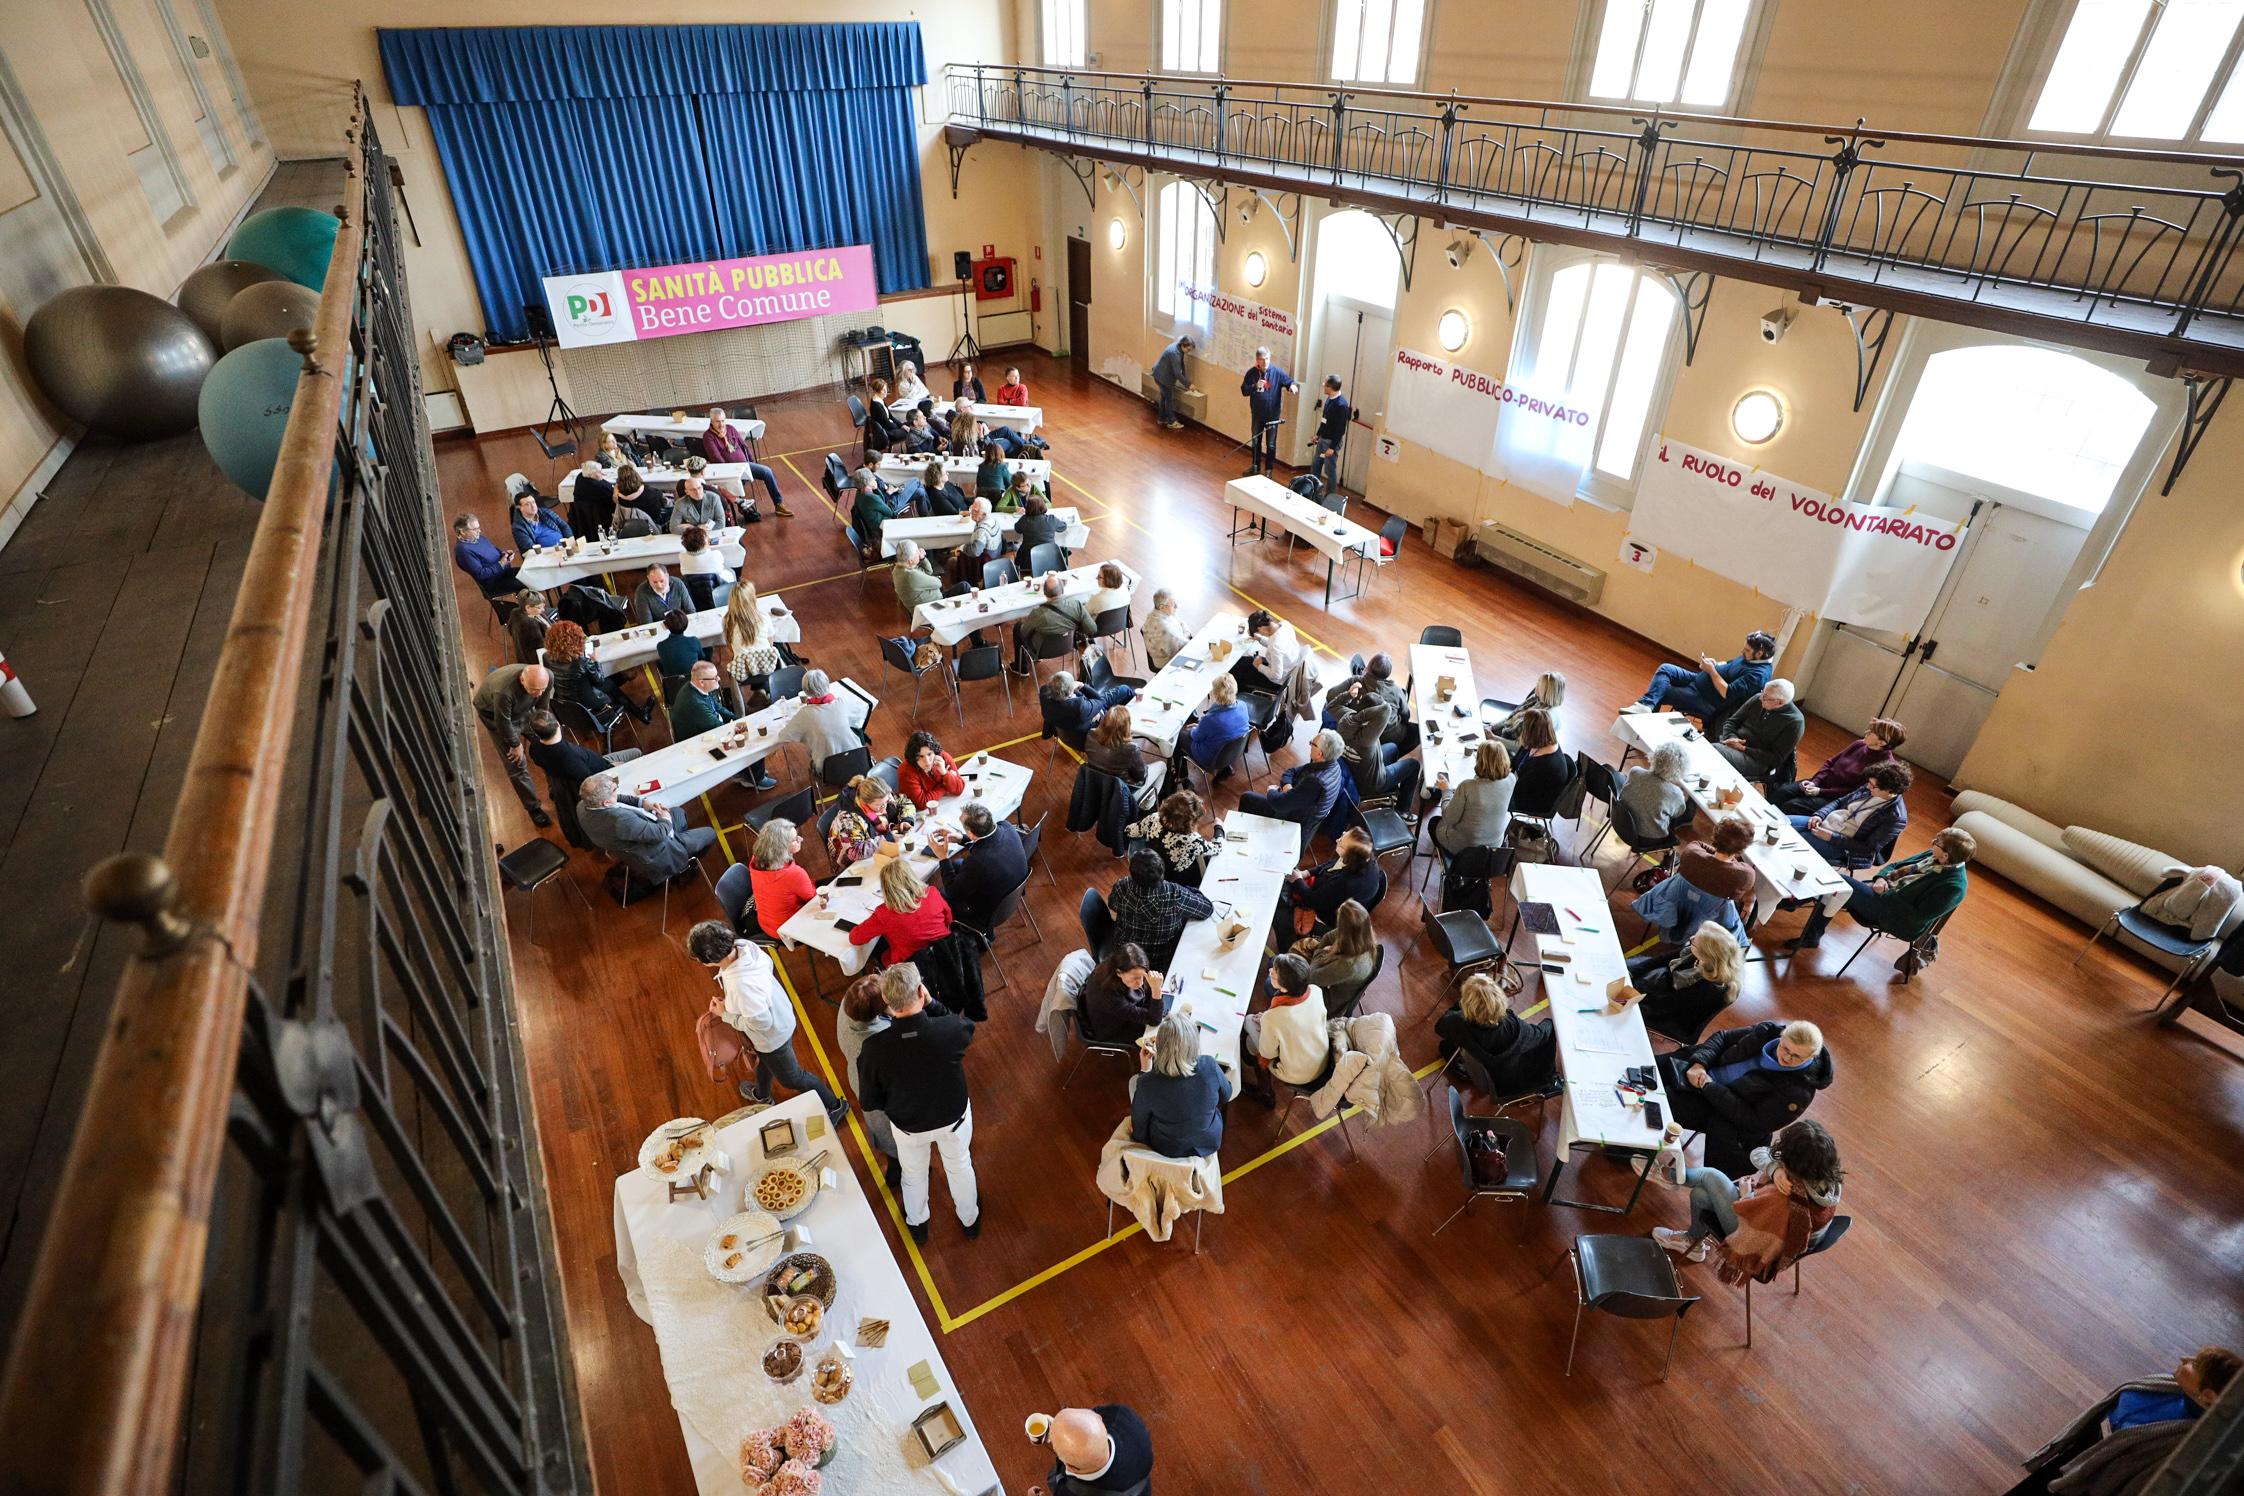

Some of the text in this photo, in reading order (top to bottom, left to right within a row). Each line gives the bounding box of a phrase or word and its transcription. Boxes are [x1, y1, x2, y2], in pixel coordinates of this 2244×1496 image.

[631, 257, 844, 303] SANITÀ PUBBLICA
[637, 288, 831, 331] Bene Comune
[1247, 309, 1258, 321] del
[1259, 306, 1287, 323] sistema
[1261, 318, 1293, 336] sanitario
[1397, 351, 1589, 427] Rapporto PUBBLICO-PRIVATO
[1681, 454, 1741, 488] RUOLO
[1750, 479, 1776, 502] del
[1790, 492, 1956, 551] VOLONTARIATO
[1632, 551, 1641, 562] 3
